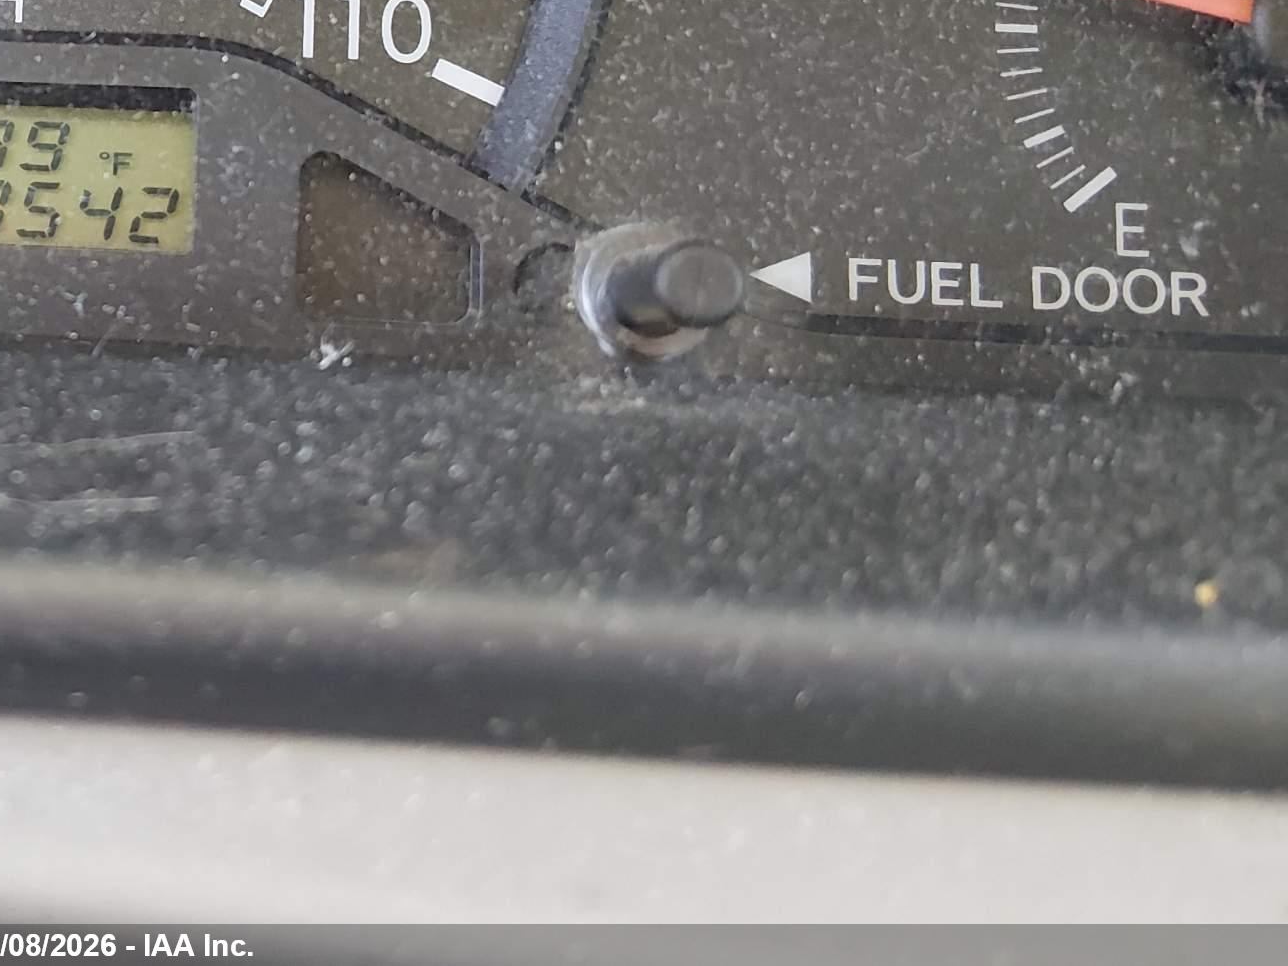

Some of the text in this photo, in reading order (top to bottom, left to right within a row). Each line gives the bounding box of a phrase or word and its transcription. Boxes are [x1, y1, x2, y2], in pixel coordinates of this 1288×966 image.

[1116, 203, 1149, 257] E
[848, 257, 1210, 317] FUEL DOOR
